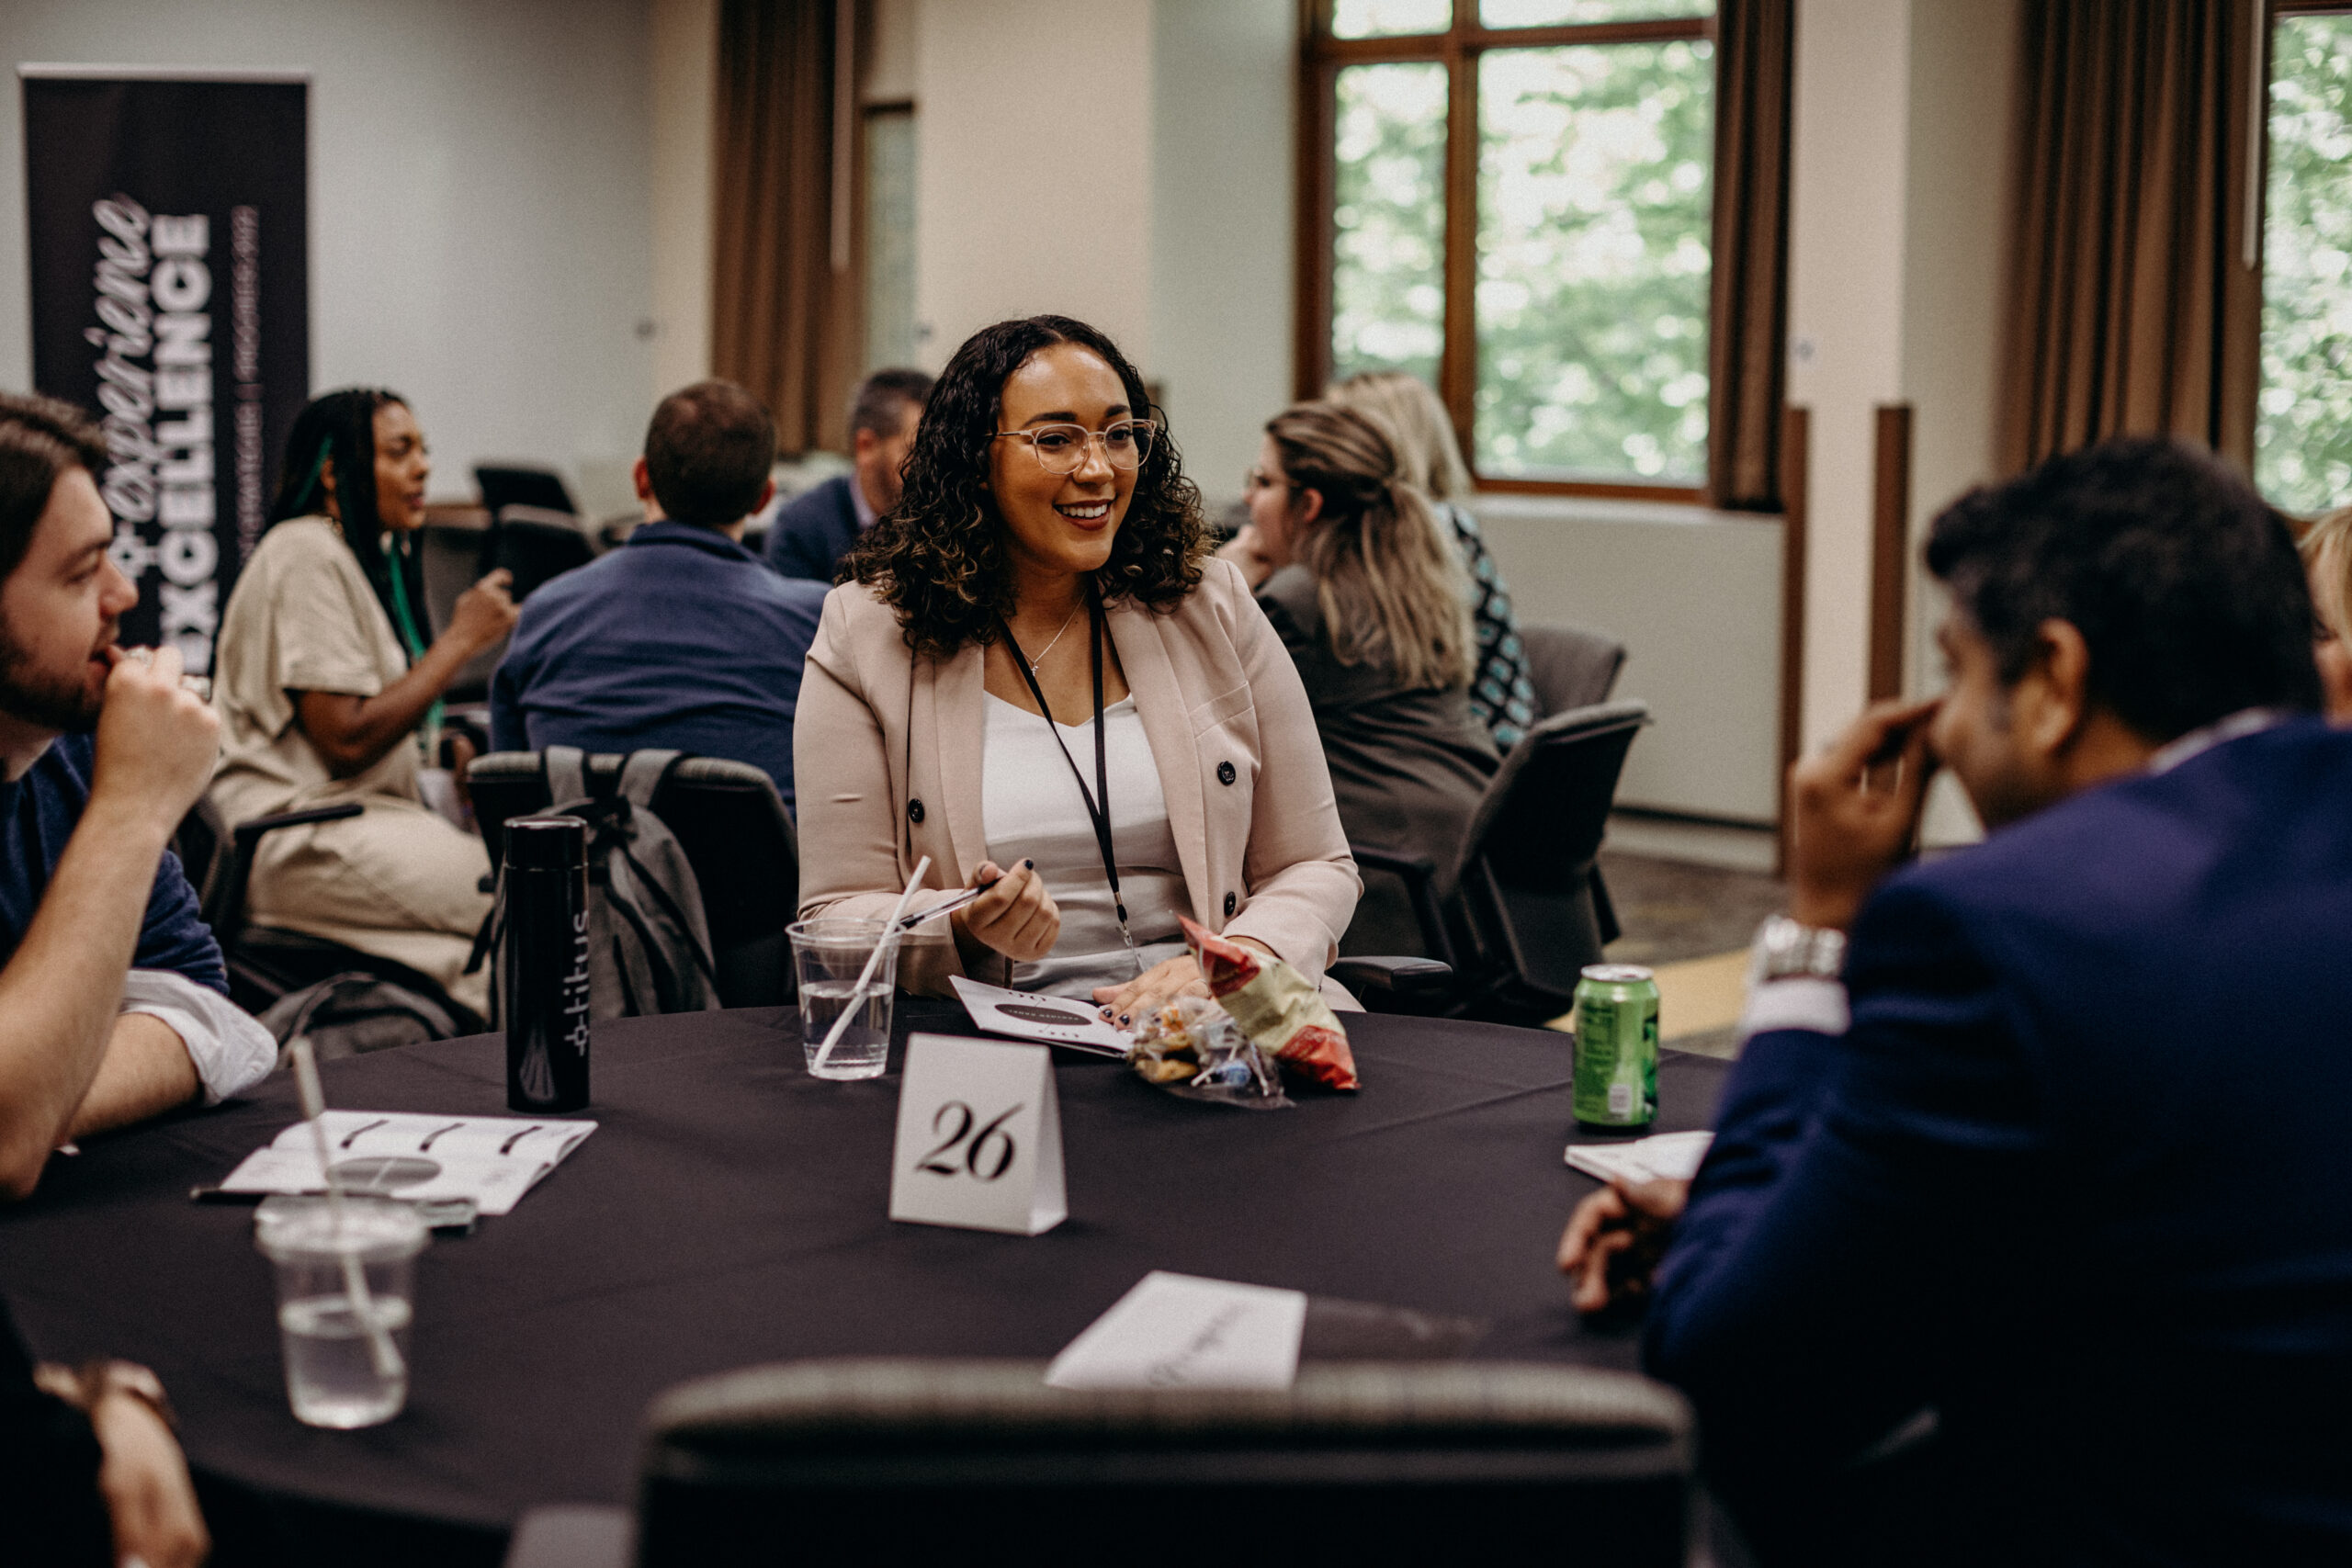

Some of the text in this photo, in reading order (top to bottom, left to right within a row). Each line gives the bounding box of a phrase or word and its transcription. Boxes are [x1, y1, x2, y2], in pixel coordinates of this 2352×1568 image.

[84, 193, 171, 523] experience
[563, 910, 589, 1014] titus
[916, 1101, 1024, 1182] 26
